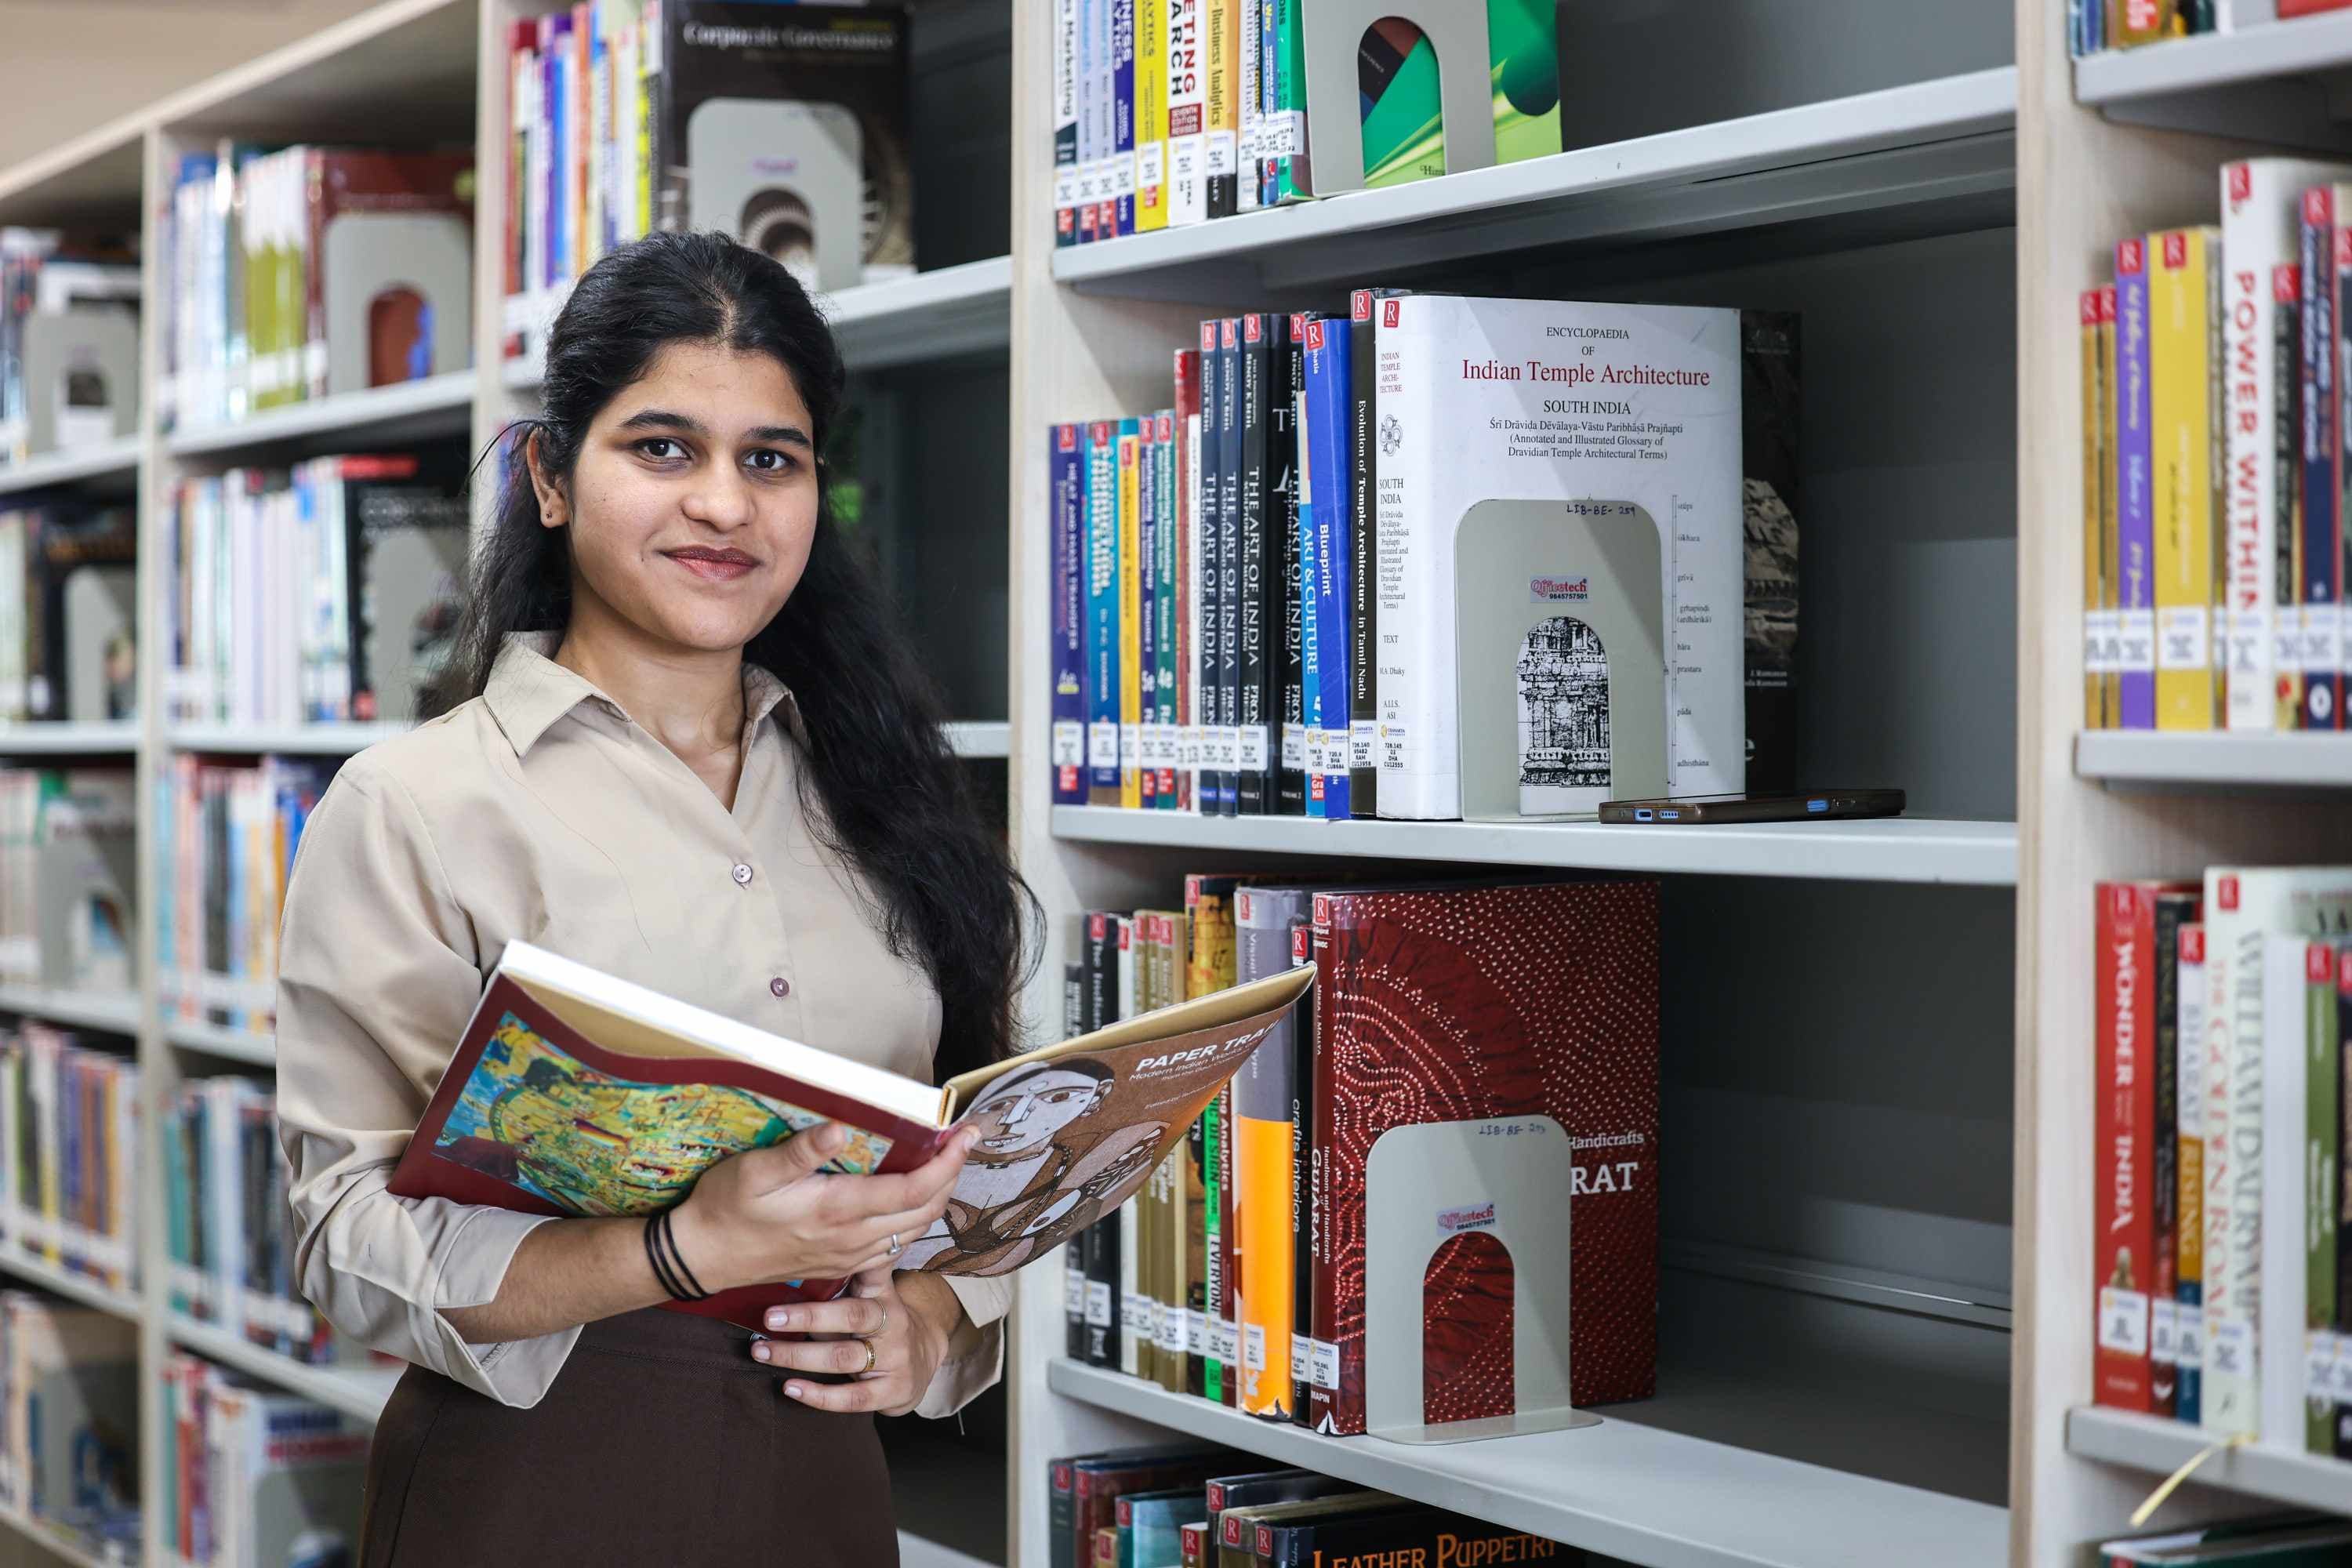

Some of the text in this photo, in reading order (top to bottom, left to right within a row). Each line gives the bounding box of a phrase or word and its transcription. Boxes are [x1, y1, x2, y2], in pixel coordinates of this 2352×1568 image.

[1209, 8, 1225, 126] Business Analytics
[1546, 327, 1629, 339] ENCYCLOPAEDIA
[1381, 352, 1399, 361] INDIAN
[1581, 346, 1595, 355] OF
[1381, 363, 1401, 372] TEMPLE
[1462, 359, 1710, 387] Indian Temple Architecture
[1380, 385, 1403, 394] TECTURE
[1544, 400, 1631, 414] SOUTH INDIA
[1508, 447, 1668, 459] Dravidian Temple Architectural Terms)
[1510, 434, 1664, 448] (Annotated and Illustrated Glossary of
[2237, 270, 2258, 611] POWER WITHIN
[1379, 478, 1404, 489] SOUTH
[1381, 494, 1402, 504] INDIA
[1318, 524, 1332, 597] Blueprint
[1357, 400, 1367, 700] Evolution of Temple Architecture in Tamil Nadu
[1205, 473, 1216, 670] THE ART OF INDIA
[1225, 471, 1236, 670] THE ART OF INDIA
[1248, 466, 1259, 666] THE ART OF INDIA
[1291, 563, 1301, 591] OF
[1305, 568, 1315, 583] &
[1290, 600, 1301, 665] INDIA
[1305, 586, 1317, 674] CULTURE
[1383, 635, 1399, 644] TEXT
[1390, 667, 1405, 677] Dhaky
[1128, 1069, 1173, 1081] Modern
[1174, 1058, 1208, 1072] Indian
[1211, 1048, 1243, 1062] Works
[1135, 1045, 1218, 1072] PAPER
[2111, 941, 2136, 1235] WONDER INDIA
[1208, 1126, 1220, 1182] DESIGN
[1568, 1130, 1645, 1150] Handicrafts
[1220, 1118, 1230, 1191] Analytics
[1292, 1098, 1302, 1232] crafts interiors
[1571, 1162, 1639, 1196] RAT
[1312, 1148, 1322, 1258] GUJARAT
[1311, 1390, 1330, 1403] MAPIN
[1313, 1534, 1557, 1568] LEATHER PUPPETRY
